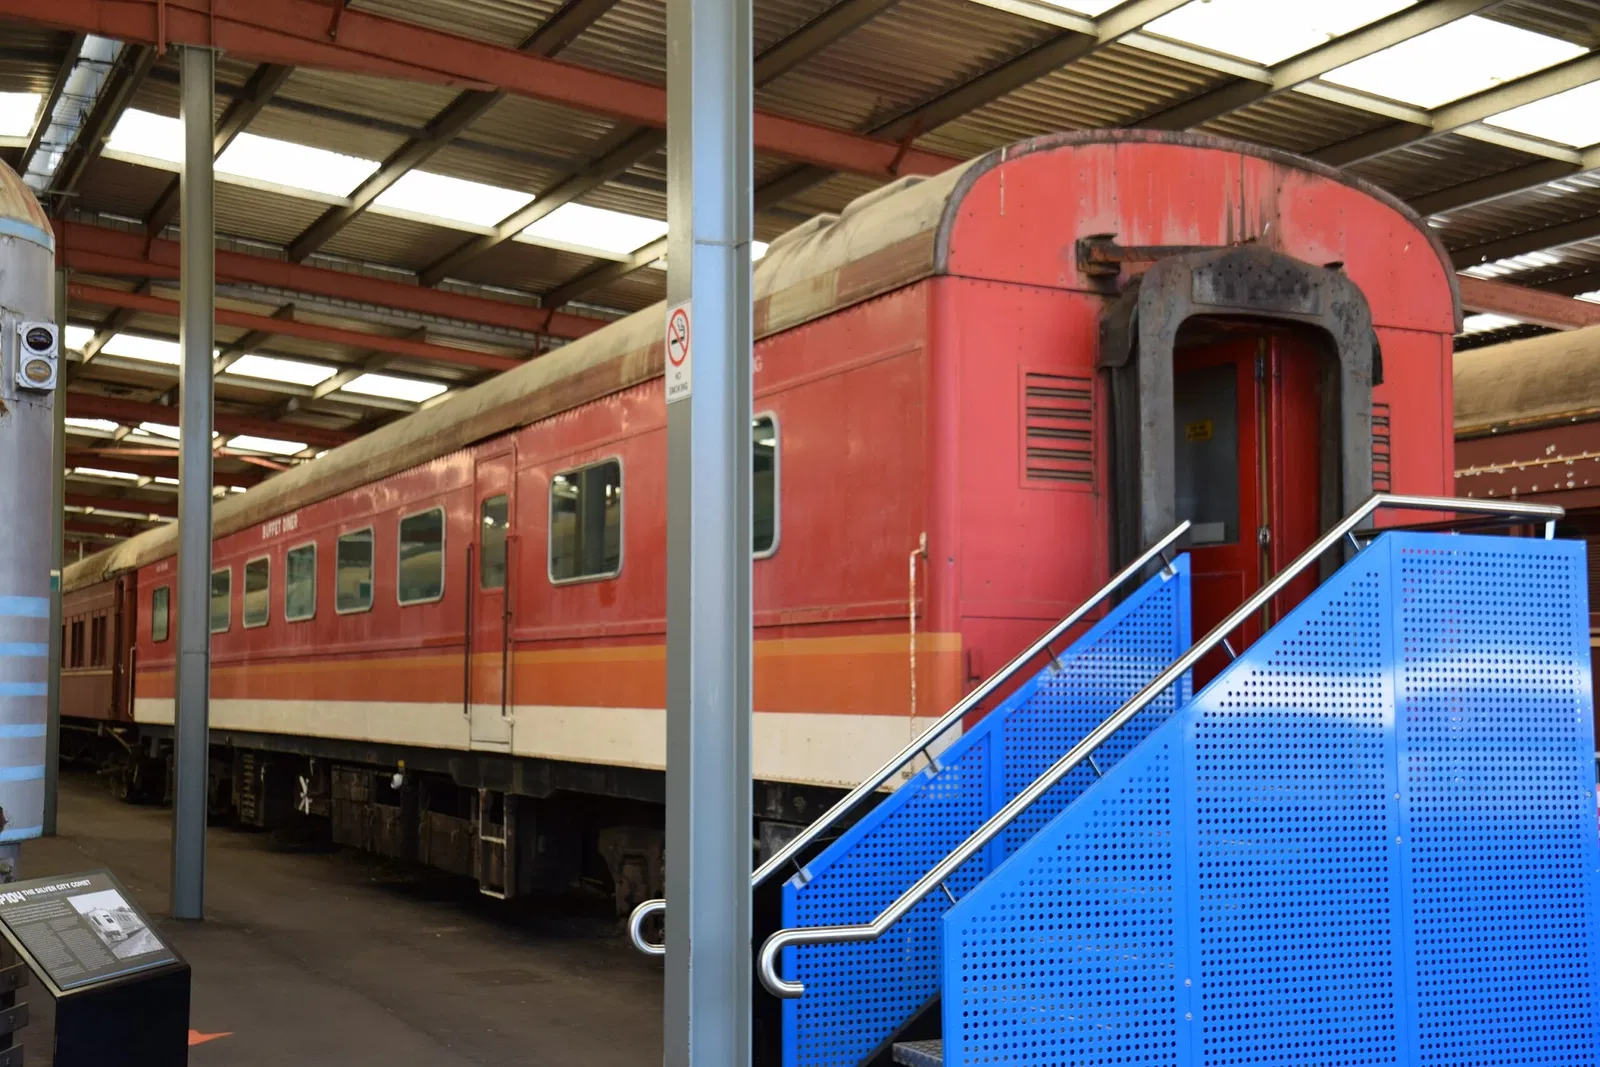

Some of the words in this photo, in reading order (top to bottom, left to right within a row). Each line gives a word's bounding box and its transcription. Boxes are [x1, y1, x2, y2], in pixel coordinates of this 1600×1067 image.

[262, 518, 281, 540] BUFFET
[282, 513, 298, 533] DINER
[0, 890, 26, 905] P104
[22, 888, 36, 896] THE
[35, 885, 57, 894] SILVER
[56, 882, 71, 890] CITY
[70, 879, 92, 888] COMET
